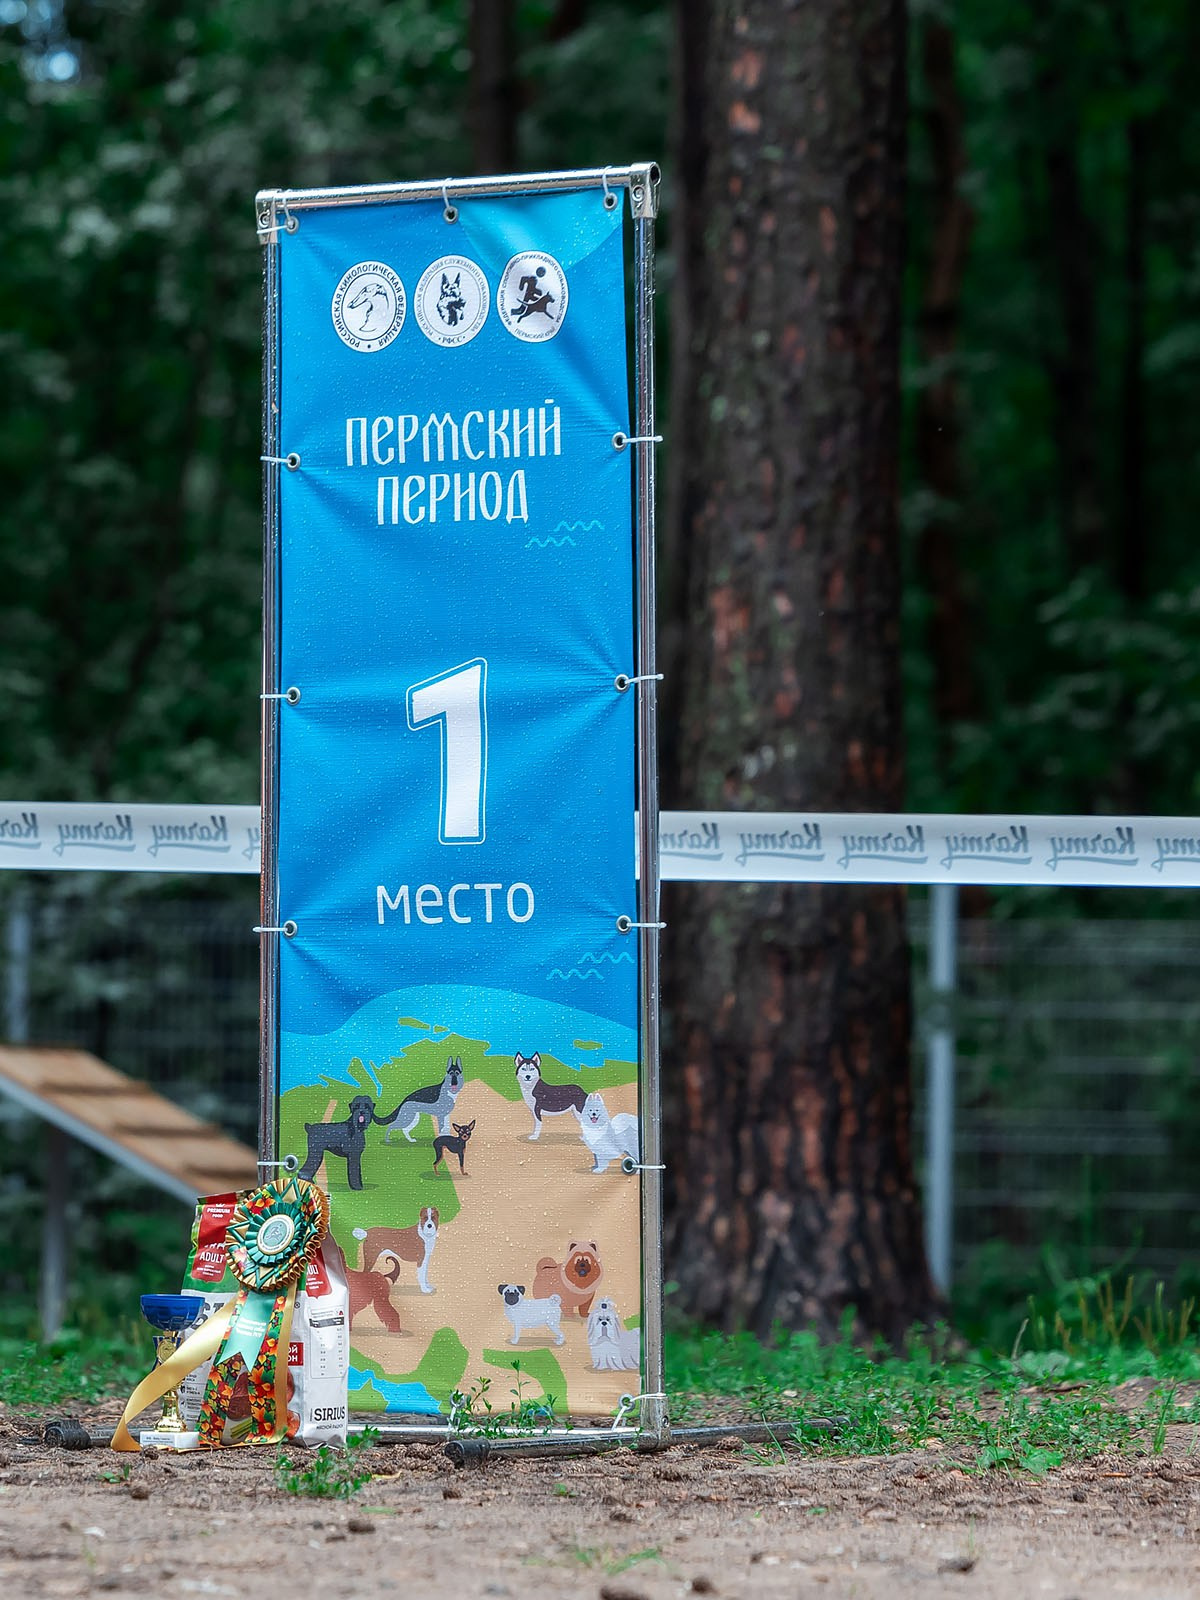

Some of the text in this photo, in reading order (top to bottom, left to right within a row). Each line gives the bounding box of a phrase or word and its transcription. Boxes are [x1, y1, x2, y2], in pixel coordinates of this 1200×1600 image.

[333, 264, 404, 349] РОССИЙСКАЯ КИНОЛОГИЧЕСКАЯ ФЕДЕРАЦИЯ
[406, 657, 487, 845] 1
[199, 1251, 224, 1263] ADULT
[314, 1406, 345, 1421] SIRIUS
